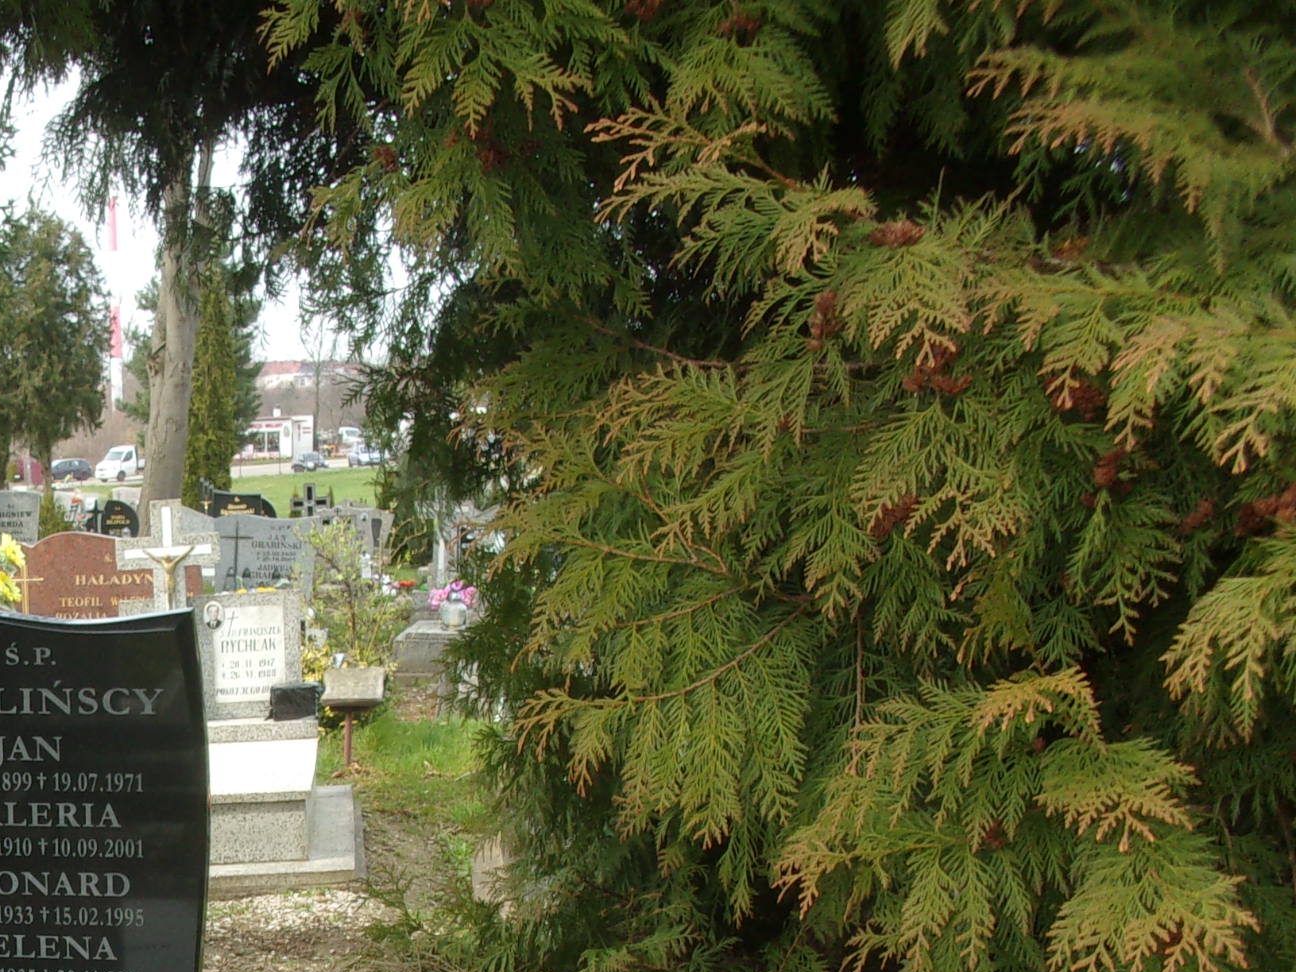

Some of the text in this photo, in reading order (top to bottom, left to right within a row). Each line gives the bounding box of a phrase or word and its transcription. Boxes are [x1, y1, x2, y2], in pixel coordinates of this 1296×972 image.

[75, 573, 153, 586] HAŁADYN
[60, 597, 103, 608] TEOFIL
[5, 642, 57, 666] Ś.P.
[53, 773, 144, 793] 19.07.1971
[54, 839, 144, 859] 10.09.2001
[54, 908, 144, 927] 15.02.1995
